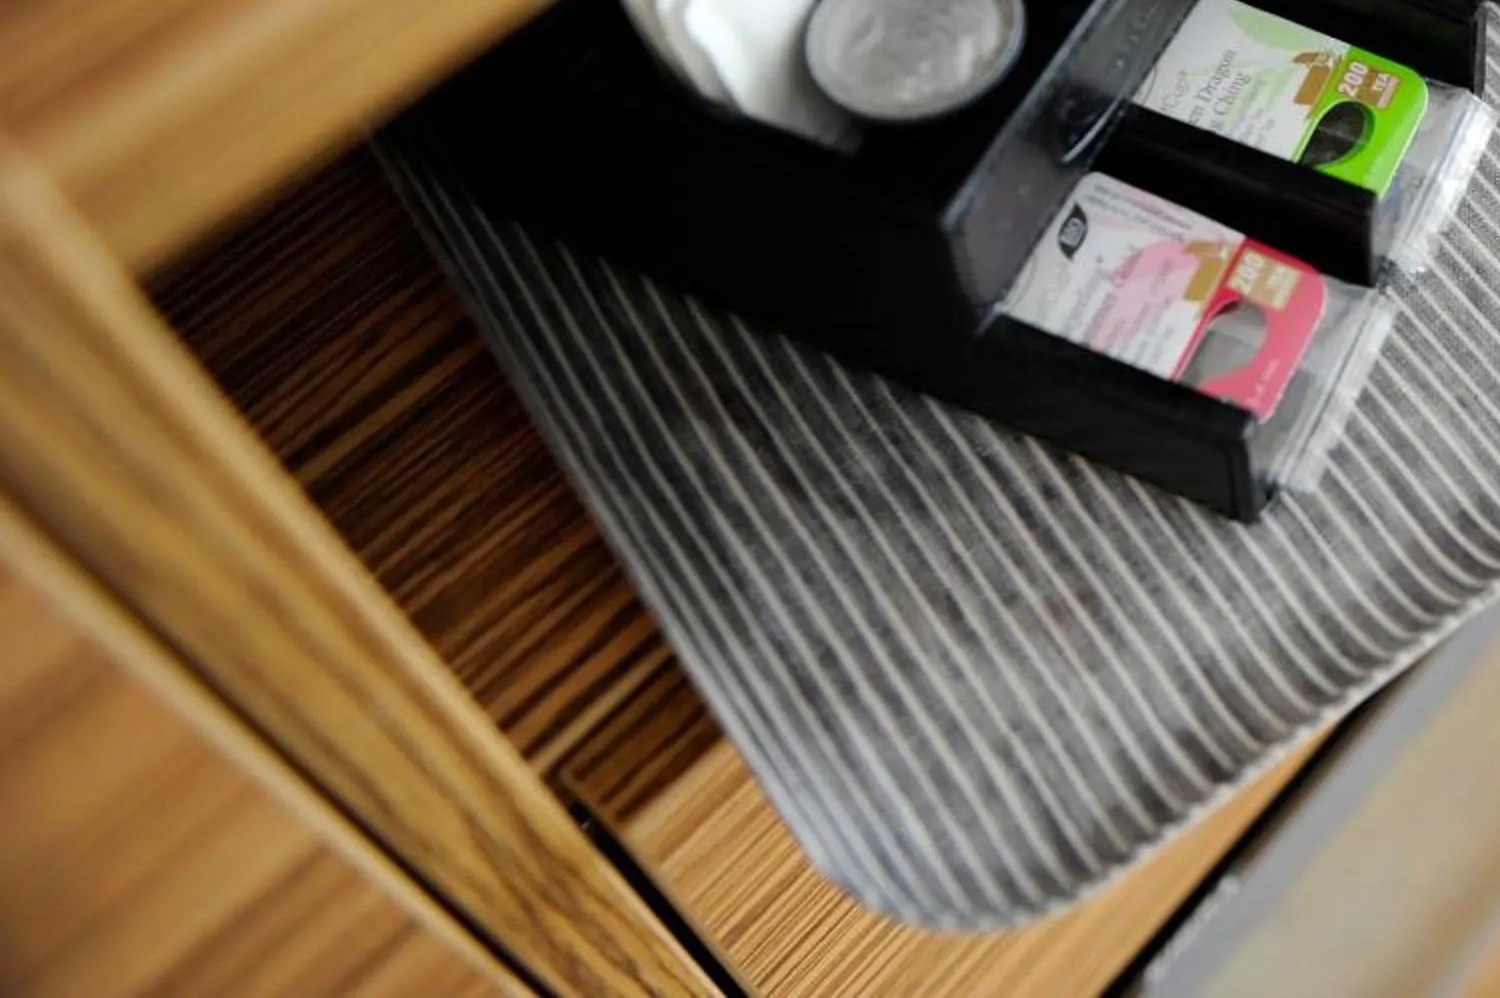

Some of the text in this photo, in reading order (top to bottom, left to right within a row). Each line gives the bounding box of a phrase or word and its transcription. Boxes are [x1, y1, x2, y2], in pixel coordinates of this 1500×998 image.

[1195, 50, 1238, 104] Dragon
[1213, 72, 1252, 116] Ching
[1338, 61, 1369, 97] 200
[1227, 250, 1266, 295] 200
